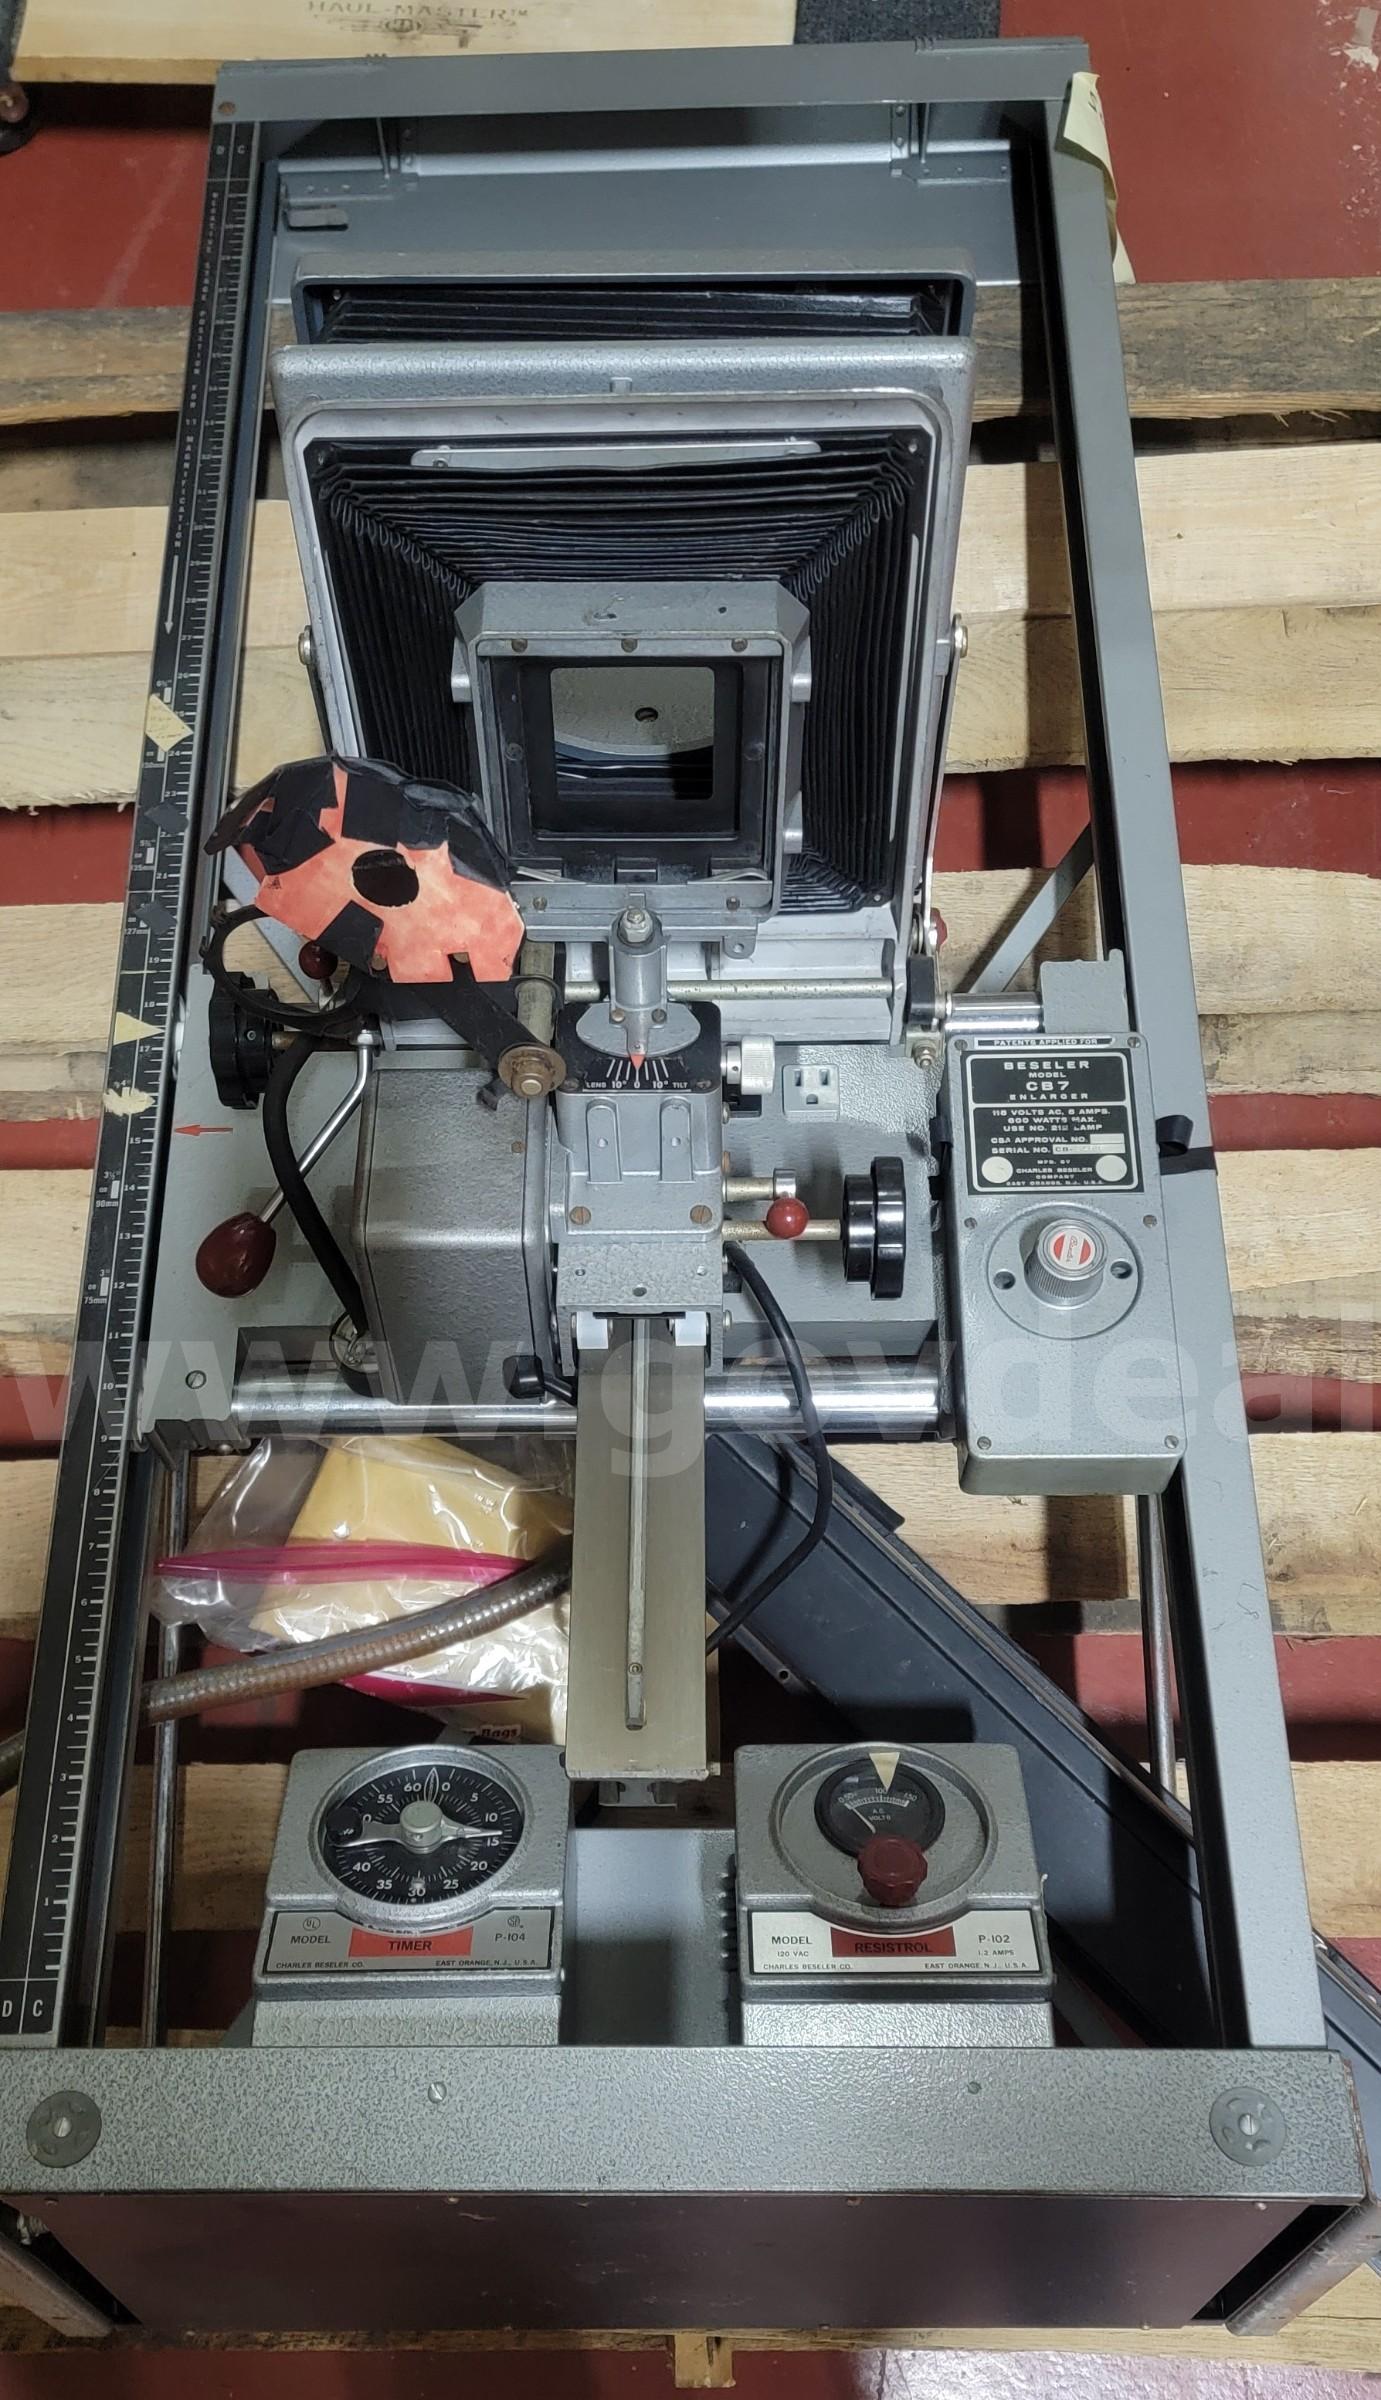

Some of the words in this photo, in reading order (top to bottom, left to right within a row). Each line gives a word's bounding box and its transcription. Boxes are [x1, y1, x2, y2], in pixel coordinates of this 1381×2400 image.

[237, 145, 246, 155] C
[1003, 1061, 1090, 1070] BESELER
[612, 1080, 628, 1089] 10°
[633, 1080, 641, 1088] 0
[653, 1080, 669, 1089] 10°
[1026, 1081, 1070, 1091] CB7
[119, 1232, 131, 1240] 13
[101, 1434, 107, 1442] 9
[88, 1542, 95, 1550] 7
[80, 1598, 87, 1606] 6
[74, 1655, 82, 1663] 5
[66, 1713, 73, 1722] 4
[59, 1773, 66, 1781] 3
[404, 1782, 421, 1792] 60
[441, 1782, 451, 1791] 0
[376, 1794, 393, 1804] 55
[470, 1792, 479, 1802] 5
[485, 1812, 498, 1822] 10
[51, 1834, 58, 1843] 2
[487, 1838, 500, 1847] 15
[352, 1862, 371, 1872] 40
[470, 1861, 488, 1871] 20
[376, 1879, 392, 1889] 35
[442, 1879, 459, 1889] 25
[408, 1887, 426, 1897] 30
[290, 1935, 331, 1944] MODEL
[495, 1932, 525, 1942] P-104
[771, 1936, 812, 1945] MODEL
[978, 1935, 1010, 1943] P-102
[388, 1940, 432, 1951] TIMER
[854, 1942, 932, 1953] RESISTROL
[276, 1961, 312, 1969] CHARLES
[351, 1960, 365, 1968] CO.
[2, 2000, 12, 2017] D
[32, 1999, 43, 2017] C
